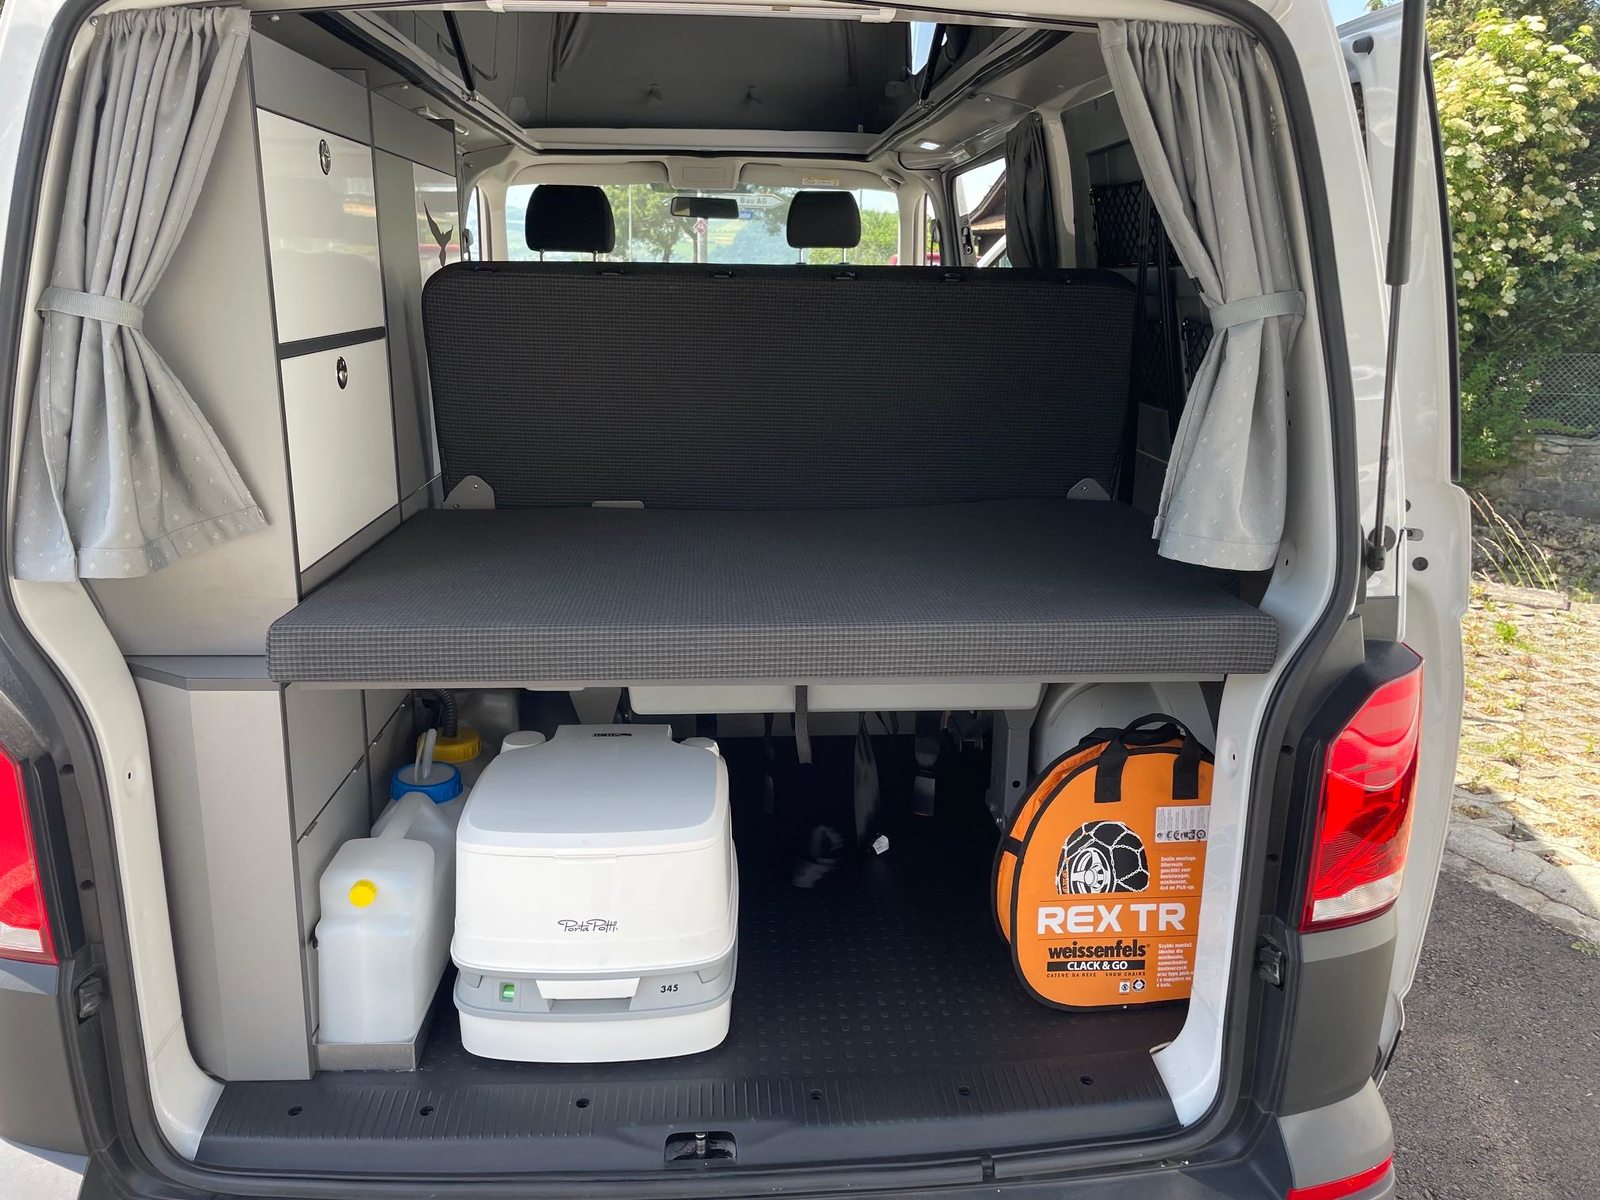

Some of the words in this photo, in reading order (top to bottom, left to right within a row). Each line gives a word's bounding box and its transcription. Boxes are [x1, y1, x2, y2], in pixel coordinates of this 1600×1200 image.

[558, 919, 589, 932] Porta
[586, 918, 618, 932] Potti
[1037, 904, 1123, 935] REX
[1130, 902, 1186, 932] TR
[1048, 939, 1146, 960] weissenfels
[1067, 961, 1101, 971] CLACK
[1101, 961, 1111, 970] &
[1112, 961, 1128, 970] GO
[660, 984, 679, 994] 345
